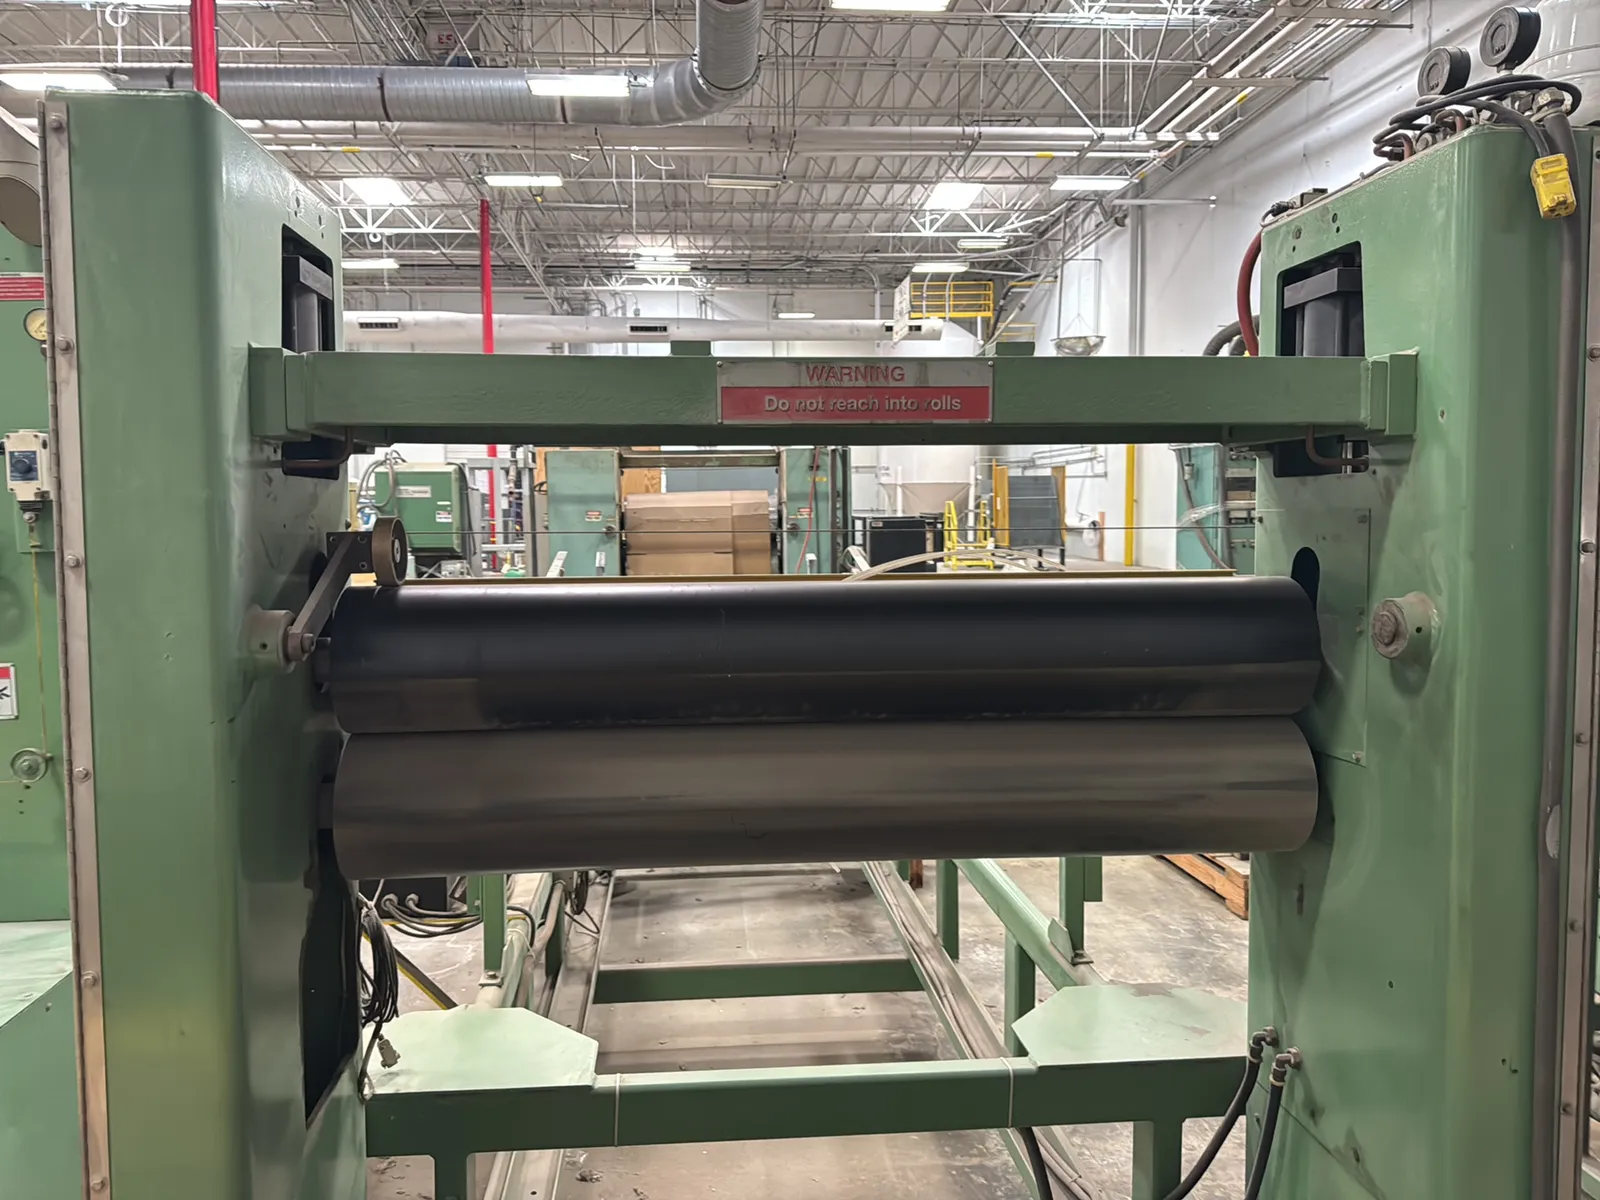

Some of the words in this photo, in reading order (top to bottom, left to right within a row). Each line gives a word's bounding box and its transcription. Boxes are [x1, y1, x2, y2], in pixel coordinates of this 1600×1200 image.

[805, 365, 905, 382] WARNING
[764, 395, 790, 412] Do
[796, 397, 825, 412] not
[830, 395, 879, 412] reach
[885, 395, 919, 411] into
[924, 395, 962, 411] rolls
